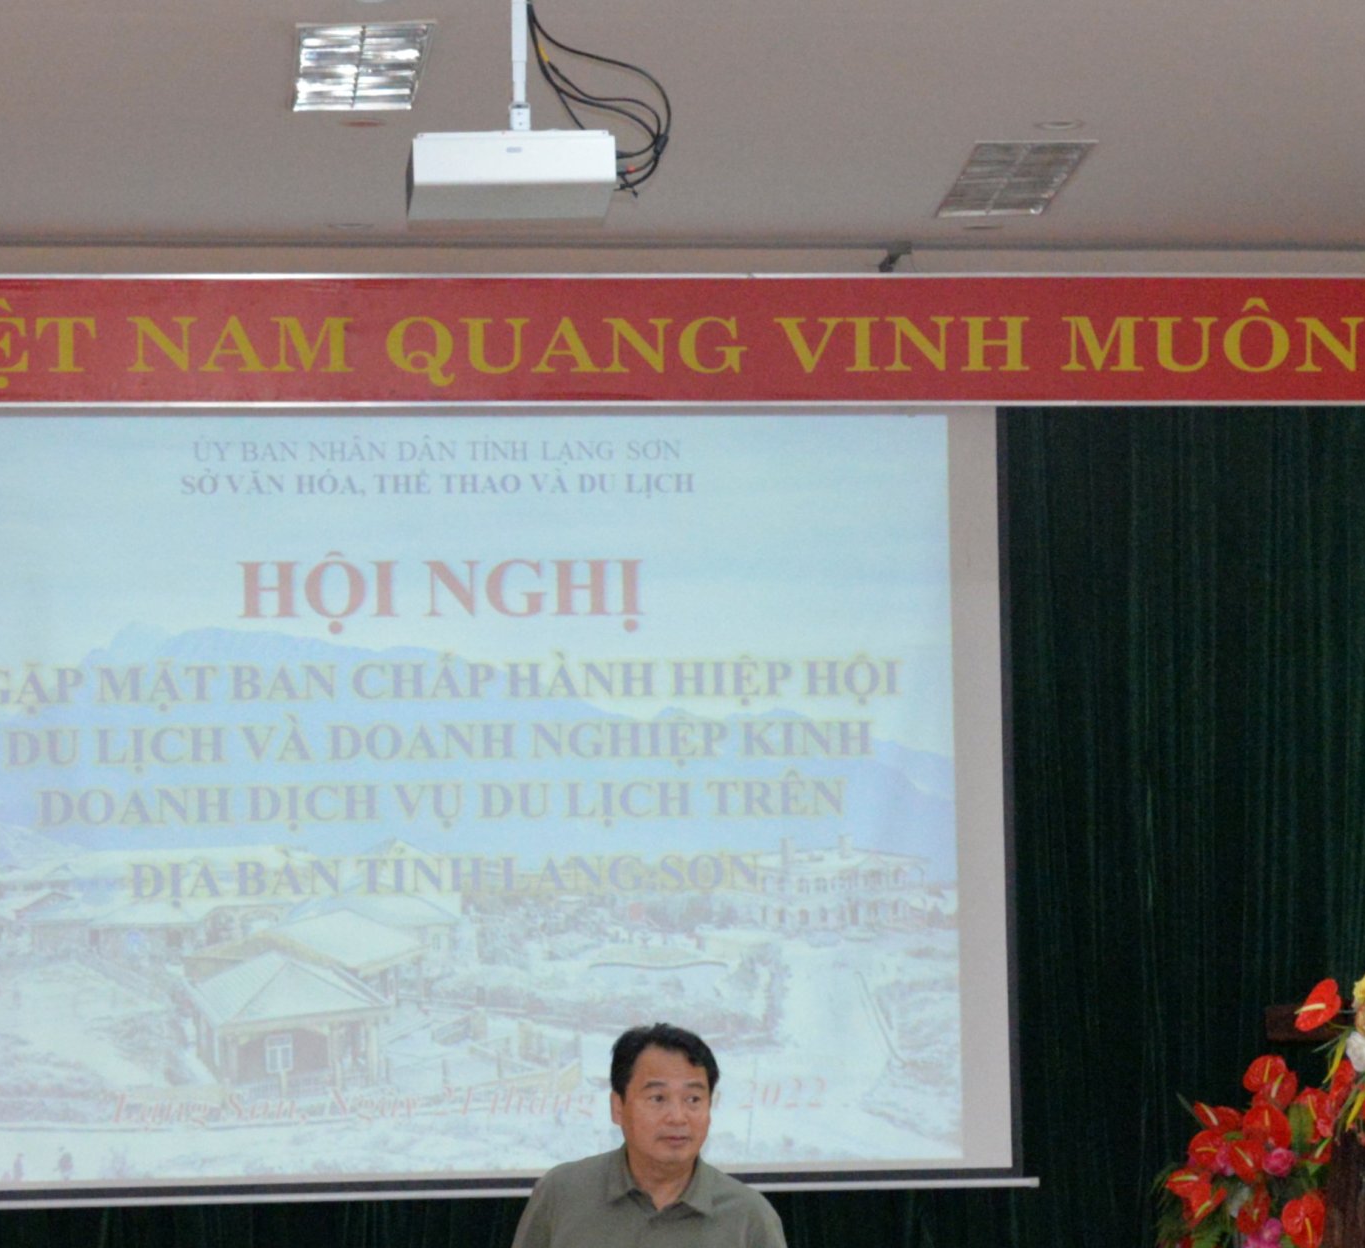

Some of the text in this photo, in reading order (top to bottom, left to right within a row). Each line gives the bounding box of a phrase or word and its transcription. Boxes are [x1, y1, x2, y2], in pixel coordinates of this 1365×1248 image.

[126, 315, 355, 372] NAM
[385, 314, 748, 386] QUANG
[773, 315, 1031, 373] VINH
[1061, 298, 1360, 375] MUÔN
[180, 469, 220, 495] SỞ
[226, 468, 287, 495] VĂN
[295, 467, 367, 497] HÓA,
[439, 473, 522, 495] THAO
[530, 467, 570, 494] VÀ
[577, 472, 619, 494] DU
[624, 472, 695, 499] LỊCH
[240, 441, 300, 463] BAN
[308, 435, 388, 463] NHÂN
[397, 435, 457, 462] DÂN
[541, 440, 615, 467] LẠNG
[625, 437, 682, 462] SƠN
[237, 549, 645, 635] HỘI NGHỊ
[95, 658, 219, 714] MẶT
[230, 663, 337, 703] BAN
[351, 650, 496, 702] CHẤP
[504, 651, 655, 701] HÀNH
[670, 654, 793, 707] HIỆP
[804, 653, 903, 707] HỘI
[6, 711, 874, 774] DU LỊCH VÀ DOANH NGHIỆP KINH
[39, 769, 849, 833] DOANH DỊCH VỤ DU LỊCH TRÊN
[131, 861, 223, 910] ĐỊA
[235, 845, 341, 898] BÀN
